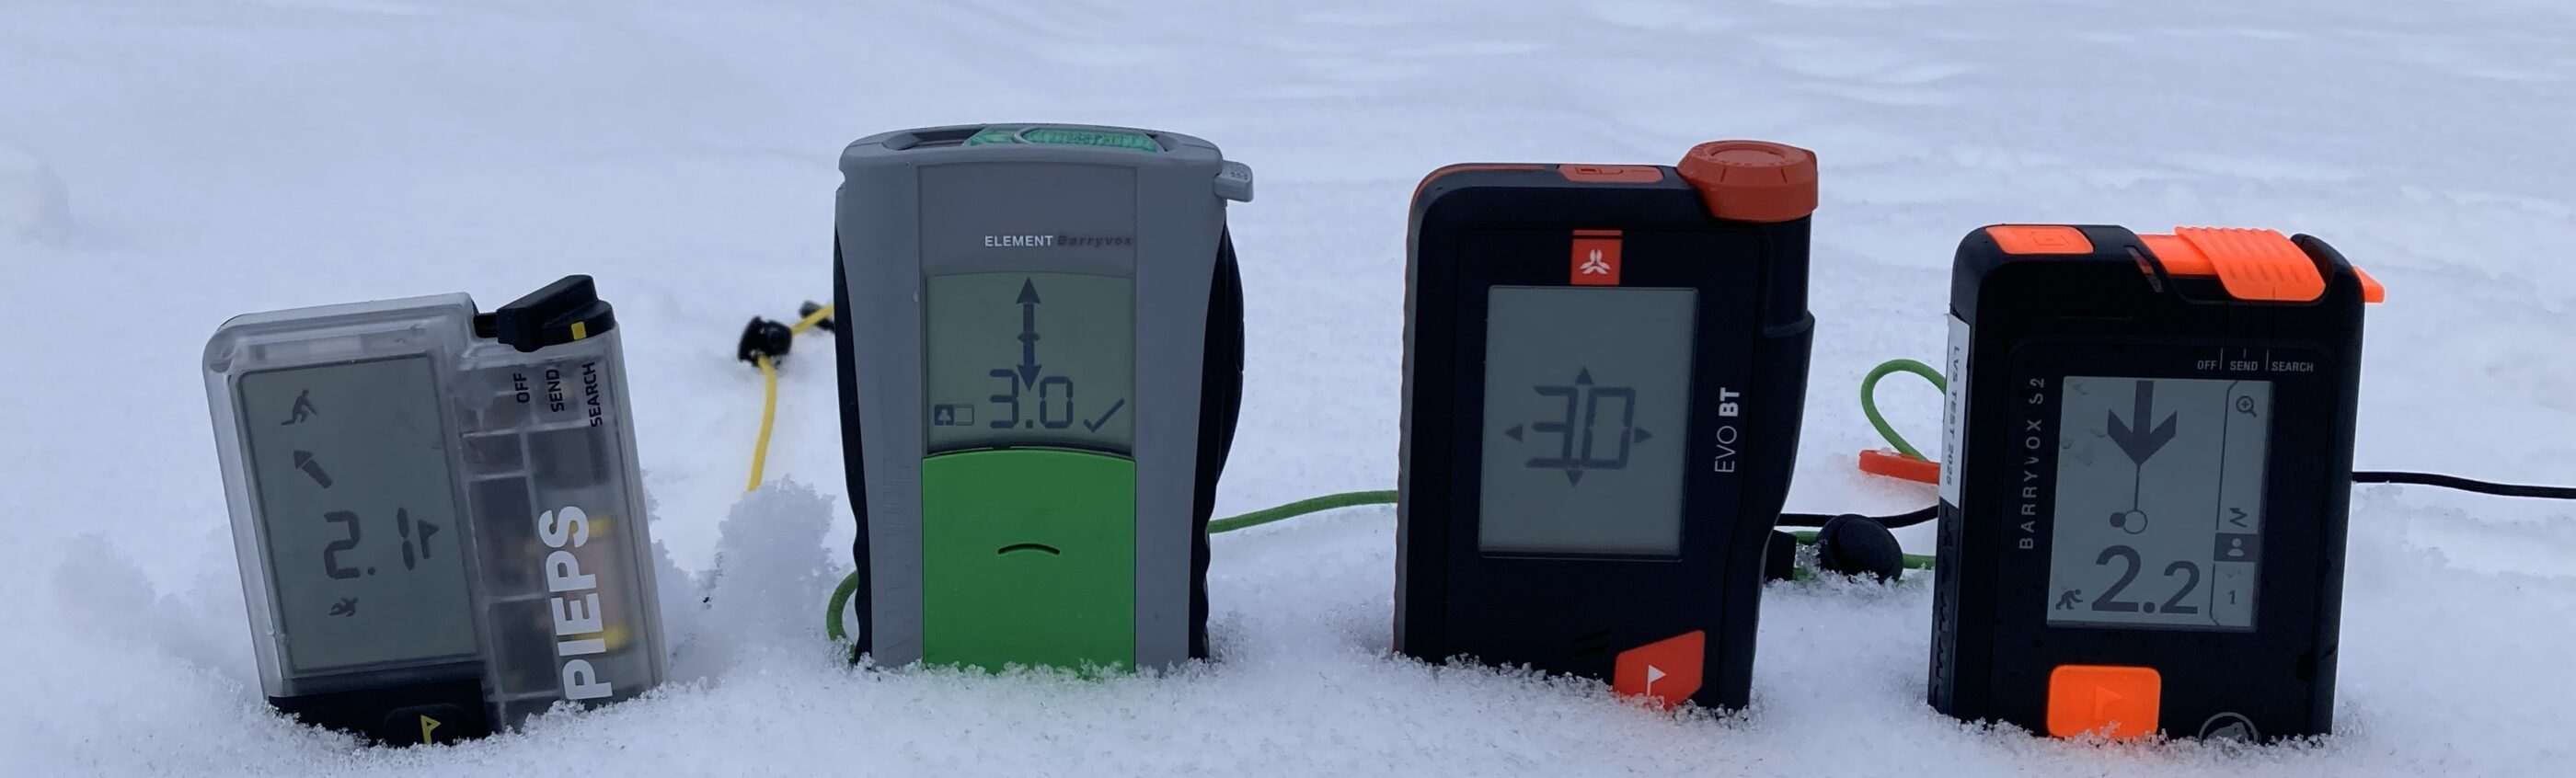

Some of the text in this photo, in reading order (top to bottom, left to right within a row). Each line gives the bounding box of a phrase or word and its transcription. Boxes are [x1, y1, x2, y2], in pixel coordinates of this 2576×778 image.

[984, 235, 1133, 248] ELEMENT Barryvox
[513, 372, 530, 403] OFF
[546, 369, 564, 412] SEND
[2197, 360, 2315, 372] OFF SEND SEARCH
[581, 361, 603, 427] SEARCH
[989, 369, 1074, 429] 3.0
[1949, 390, 1957, 440] TEST
[1714, 387, 1741, 473] EVO BT
[2019, 419, 2042, 550] BARRYVOX
[538, 506, 613, 699] PIEPS
[2091, 544, 2201, 614] 2.2
[2227, 589, 2237, 605] 1
